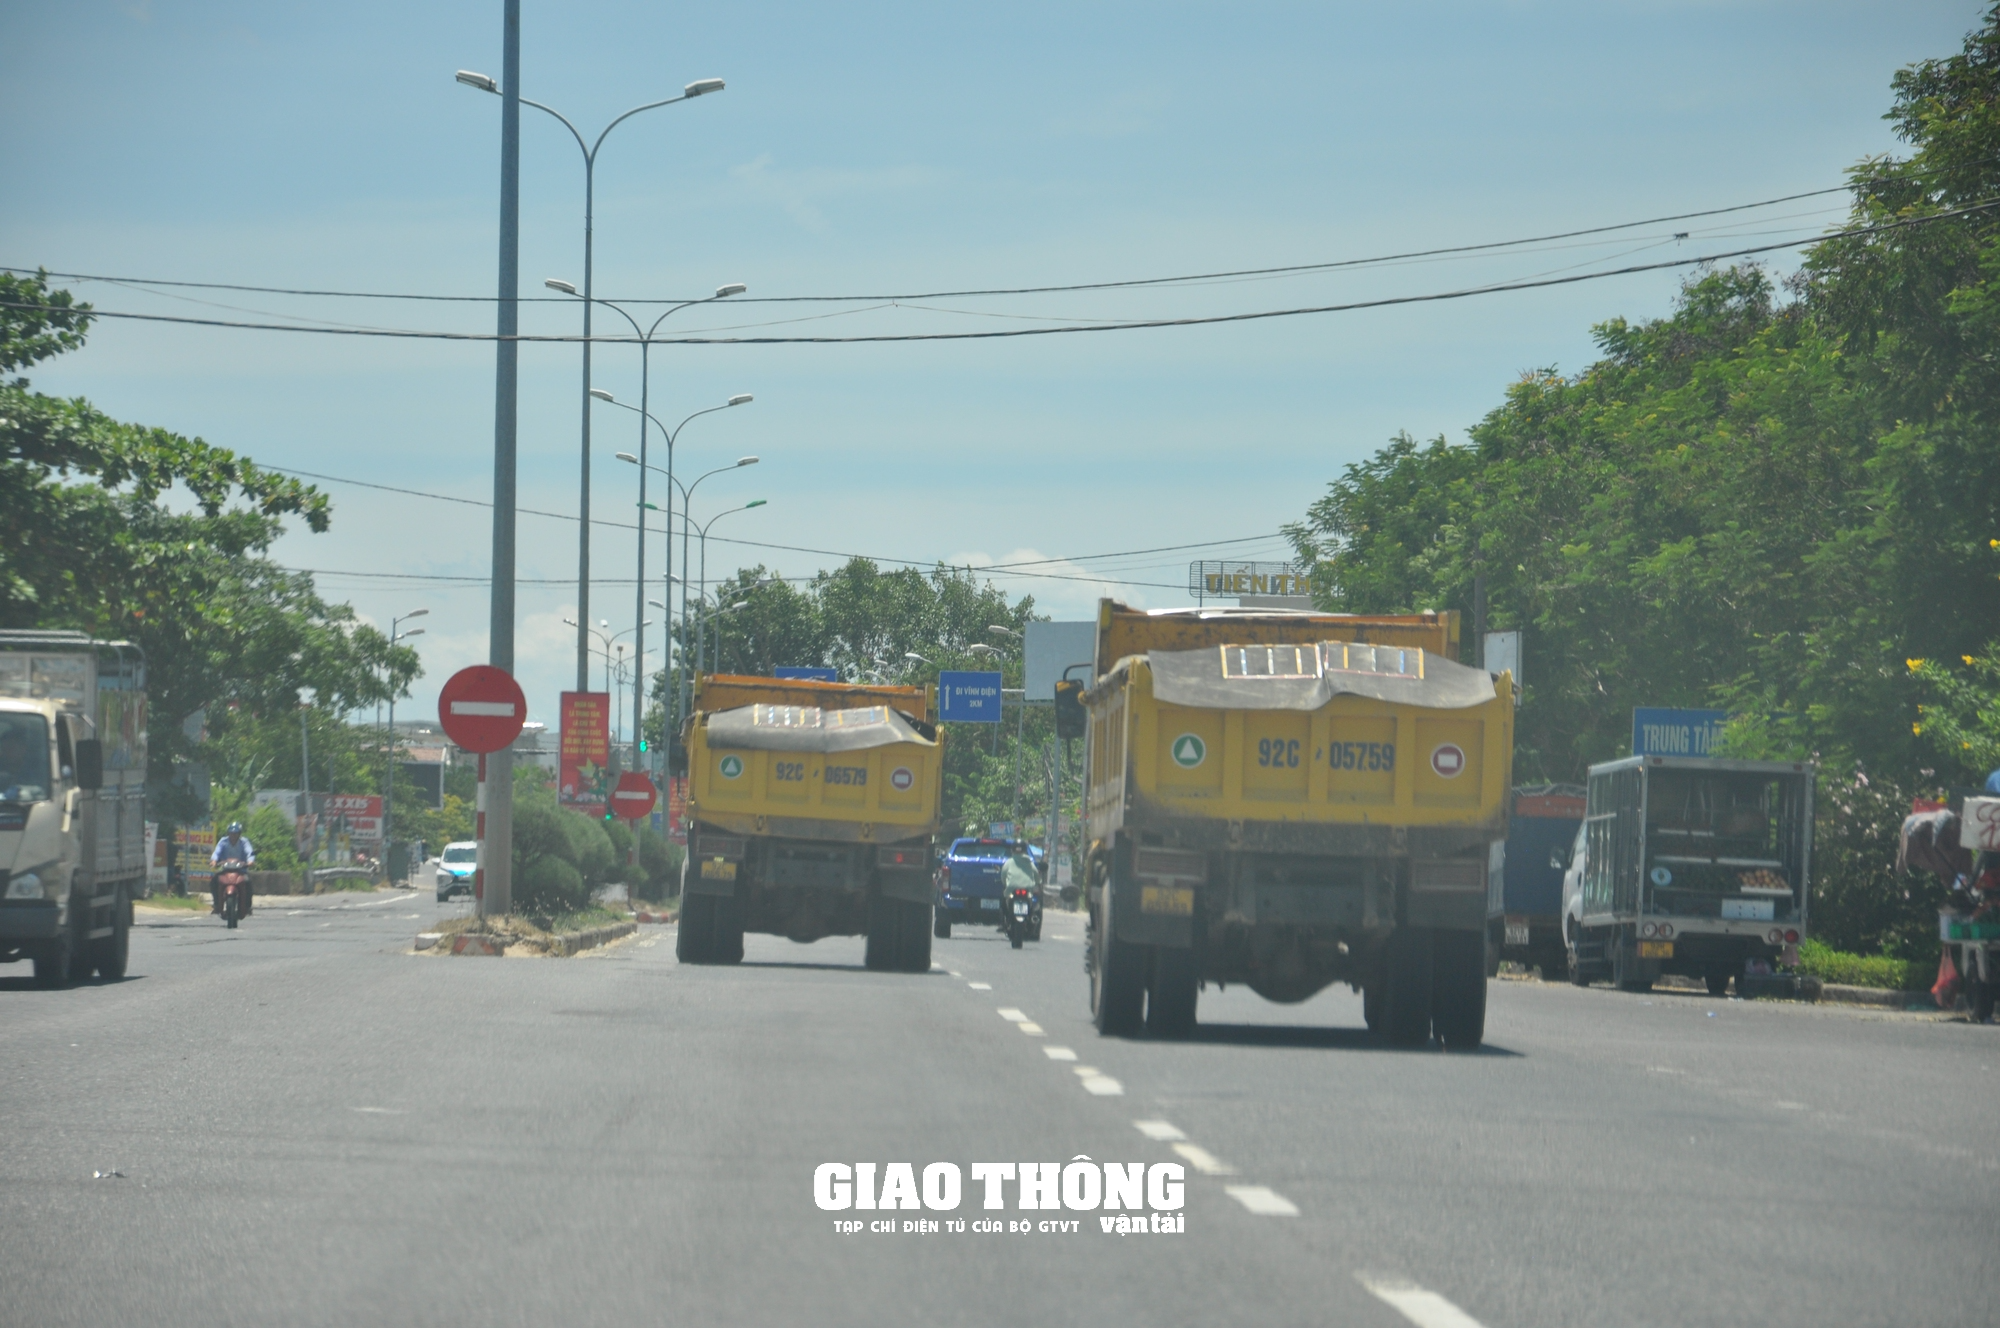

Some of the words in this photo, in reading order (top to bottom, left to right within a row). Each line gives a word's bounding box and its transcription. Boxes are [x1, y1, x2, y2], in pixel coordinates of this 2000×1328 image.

[1205, 565, 1268, 594] TIẾN
[969, 699, 983, 708] 2KM
[1643, 724, 1690, 753] TRUNG
[1258, 737, 1300, 769] 92C
[1329, 740, 1396, 772] 05759
[776, 761, 805, 782] 92C
[824, 765, 867, 786] 06579
